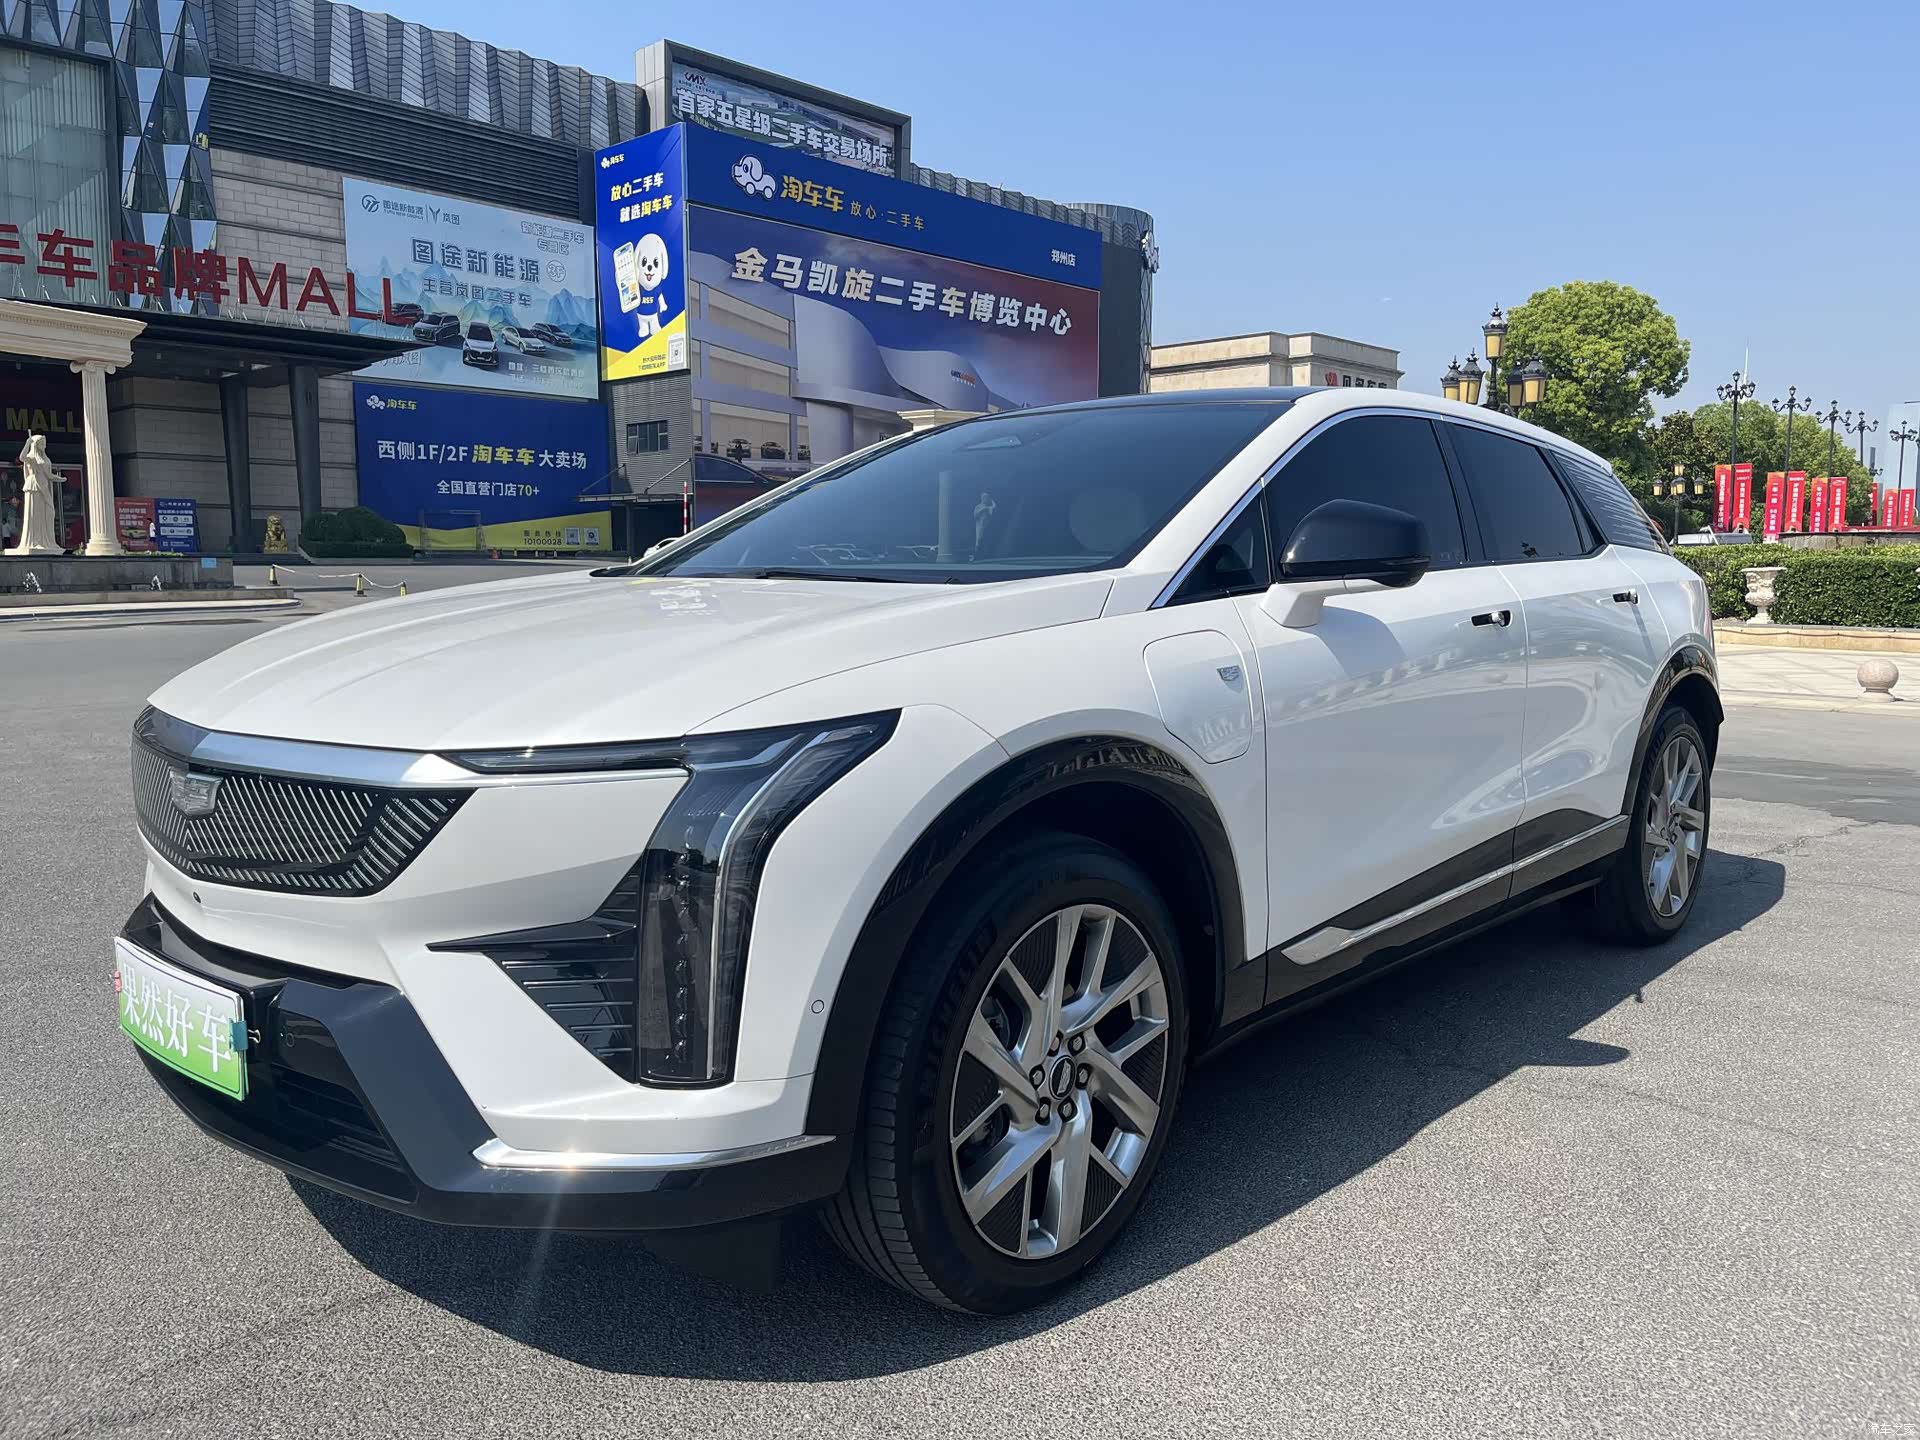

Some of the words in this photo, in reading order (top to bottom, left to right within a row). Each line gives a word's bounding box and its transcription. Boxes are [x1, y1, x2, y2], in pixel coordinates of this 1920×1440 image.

[677, 88, 890, 169] 首家五星级二手车交易场所
[610, 172, 664, 202] 放心二手车
[780, 174, 845, 213] 淘车车
[619, 194, 673, 223] 就选淘车车
[412, 238, 540, 283] 图途新能源
[1051, 248, 1076, 268] 郑州店
[423, 278, 532, 307] 主营岚图二手车
[731, 246, 1073, 337] 金马凯旋二手车博览中心
[5, 407, 82, 433] MALL
[436, 479, 540, 497] 全国直营门店70+
[121, 962, 232, 1073] 果然好车
